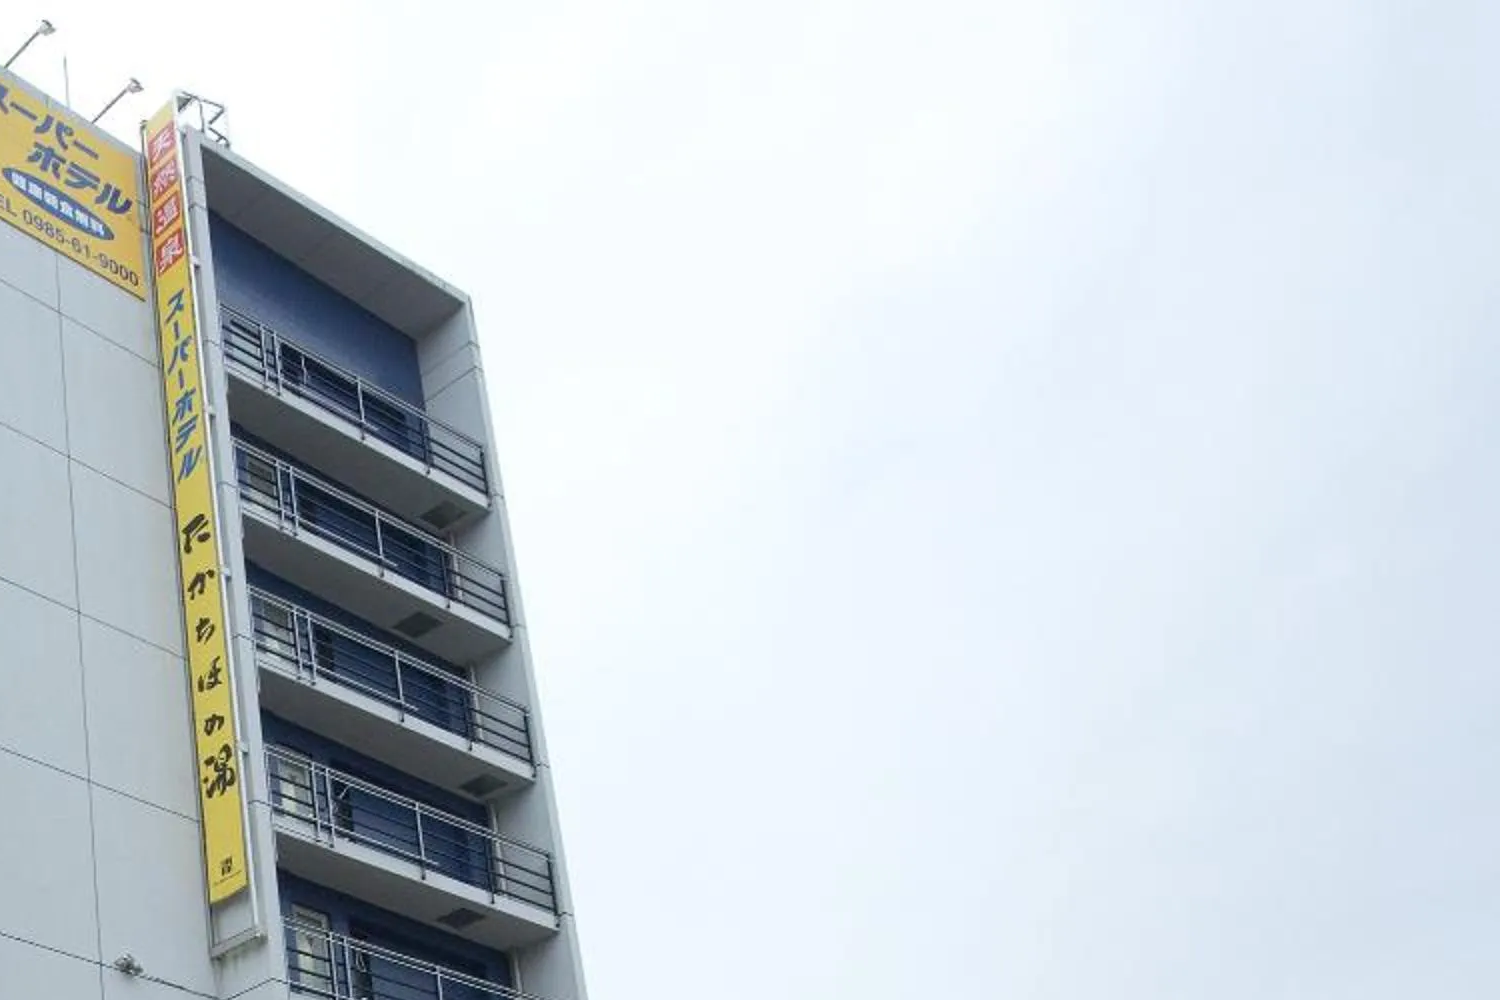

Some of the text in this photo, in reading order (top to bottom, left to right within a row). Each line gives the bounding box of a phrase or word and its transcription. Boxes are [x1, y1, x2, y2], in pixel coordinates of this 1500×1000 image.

[27, 141, 134, 215] ホテル
[151, 127, 183, 275] 天然温泉
[23, 210, 140, 287] 0985-61-9000
[166, 287, 201, 483] スーパーホテル
